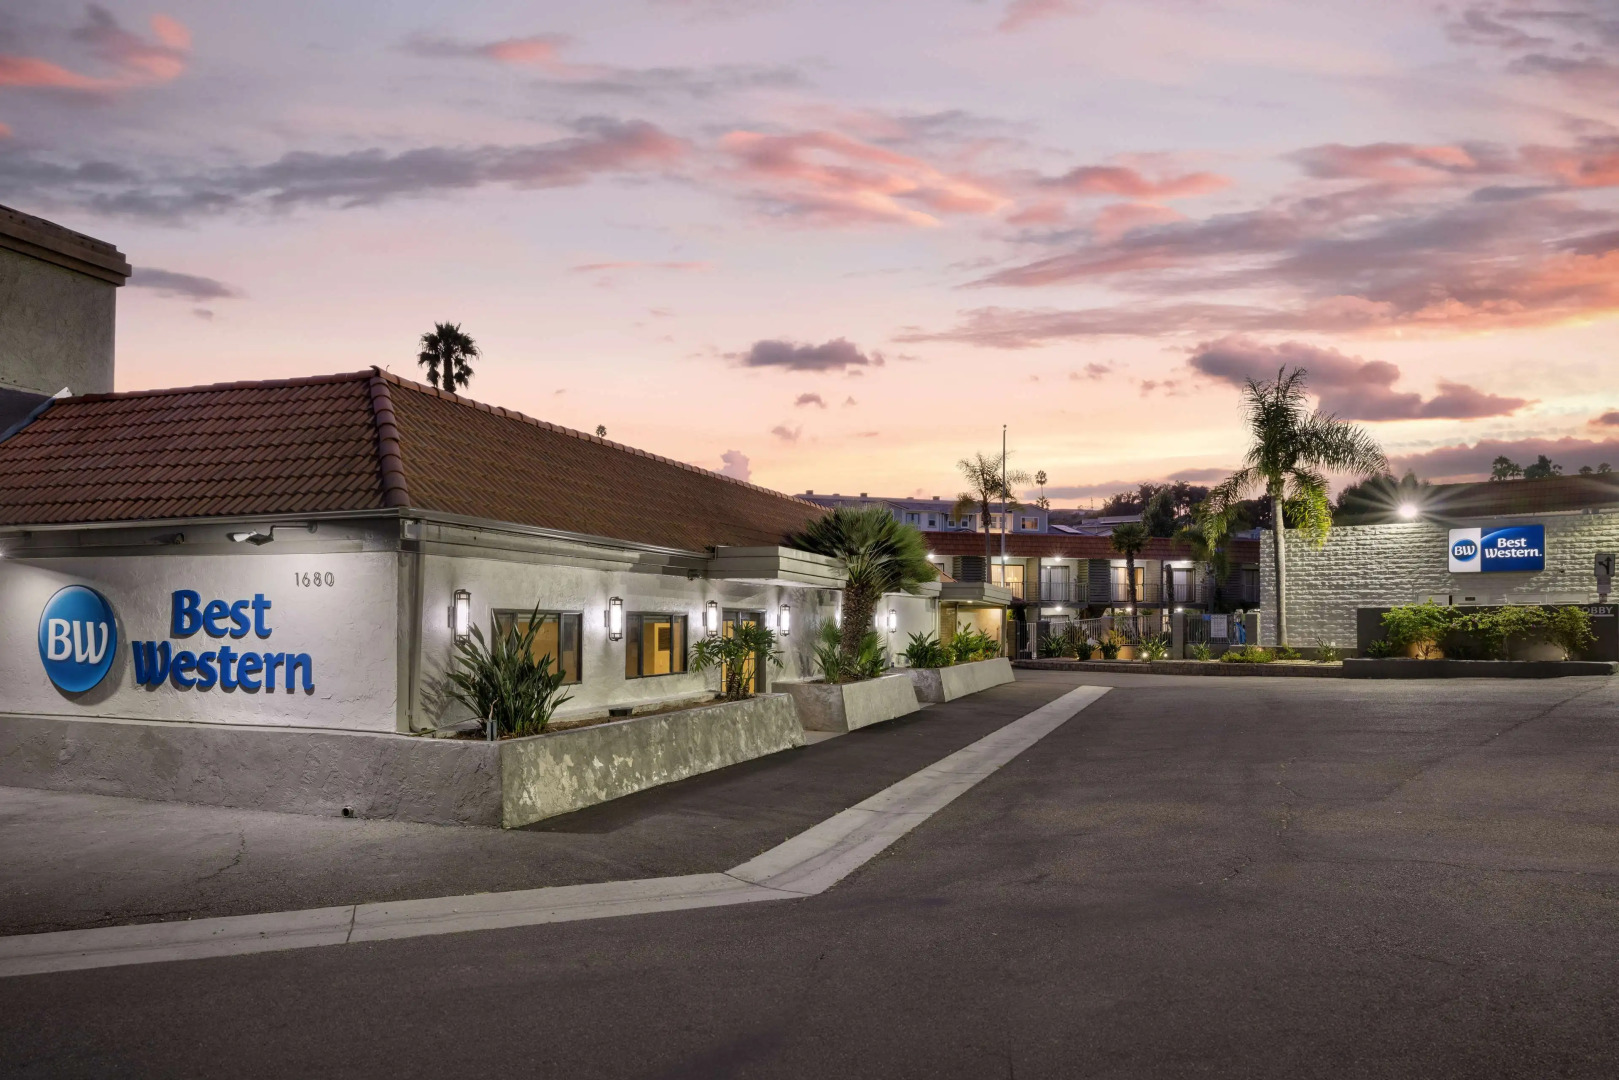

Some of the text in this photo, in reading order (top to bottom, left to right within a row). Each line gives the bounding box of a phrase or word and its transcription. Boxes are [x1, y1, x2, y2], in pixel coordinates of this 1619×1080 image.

[1454, 545, 1476, 556] BW
[1497, 537, 1527, 548] Best
[295, 571, 335, 588] 1680
[173, 589, 272, 638] Best
[1581, 606, 1613, 614] OBBY
[47, 618, 109, 665] BW
[132, 640, 315, 694] Western
